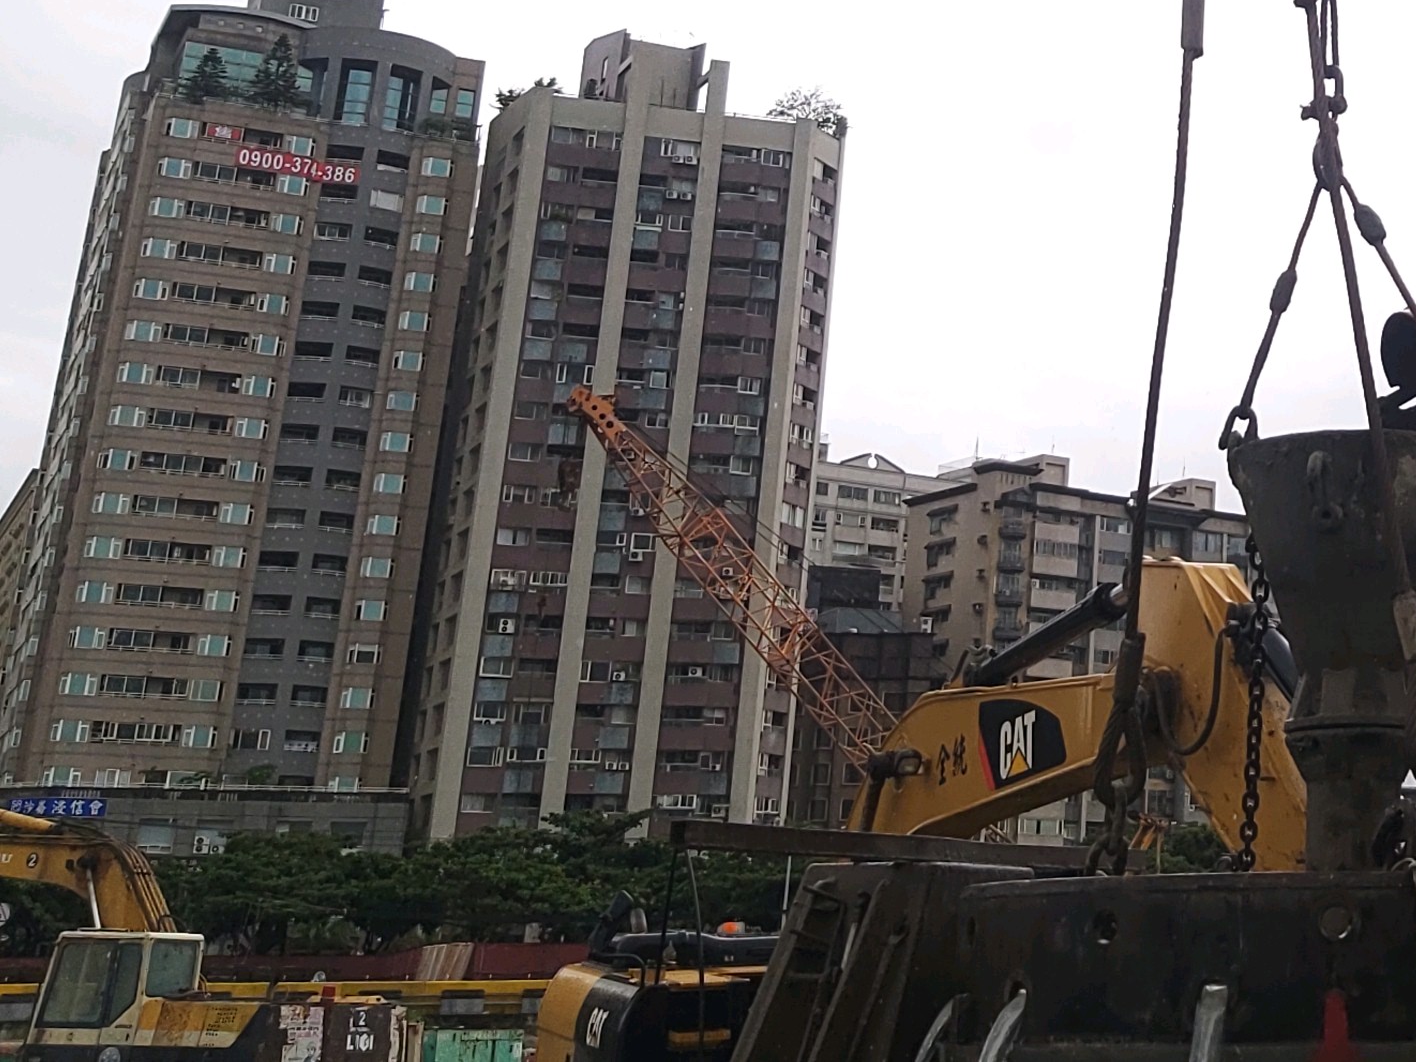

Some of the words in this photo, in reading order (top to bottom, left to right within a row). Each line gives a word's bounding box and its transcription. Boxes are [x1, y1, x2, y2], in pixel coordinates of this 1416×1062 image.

[1000, 709, 1036, 780] CAT
[28, 854, 37, 867] 2
[586, 1007, 610, 1049] CAT
